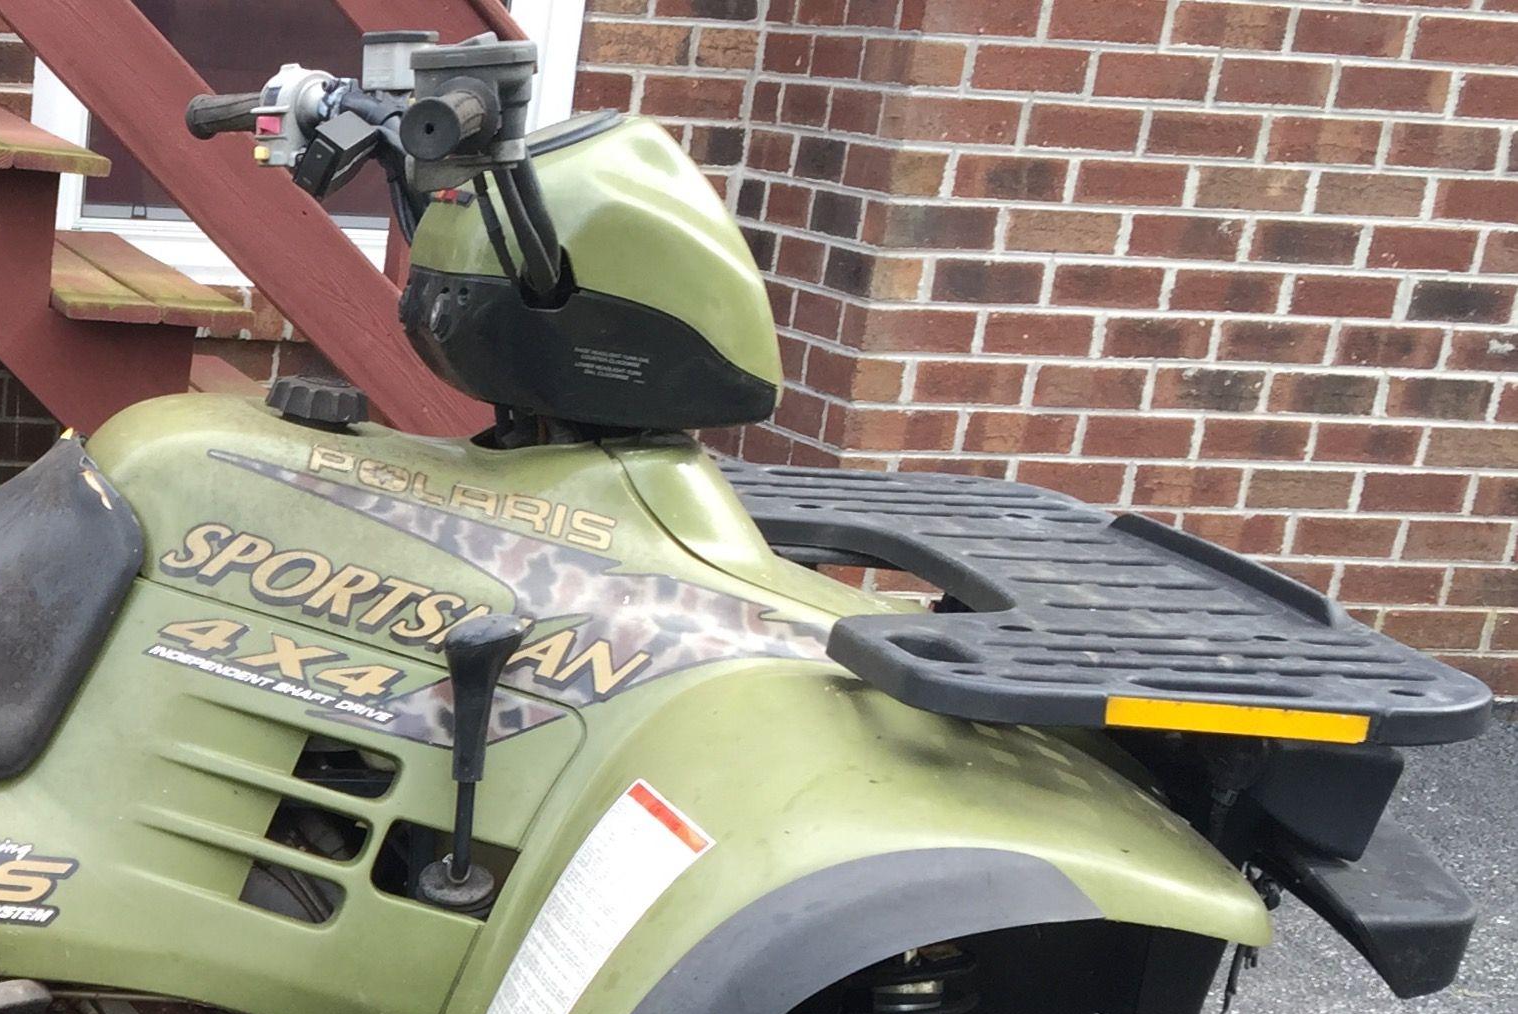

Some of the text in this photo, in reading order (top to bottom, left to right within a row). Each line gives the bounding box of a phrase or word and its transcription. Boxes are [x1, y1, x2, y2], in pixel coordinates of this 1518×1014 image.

[308, 444, 618, 551] POLARIS
[148, 645, 395, 723] INDEPENDENT SHAFT DRIVE
